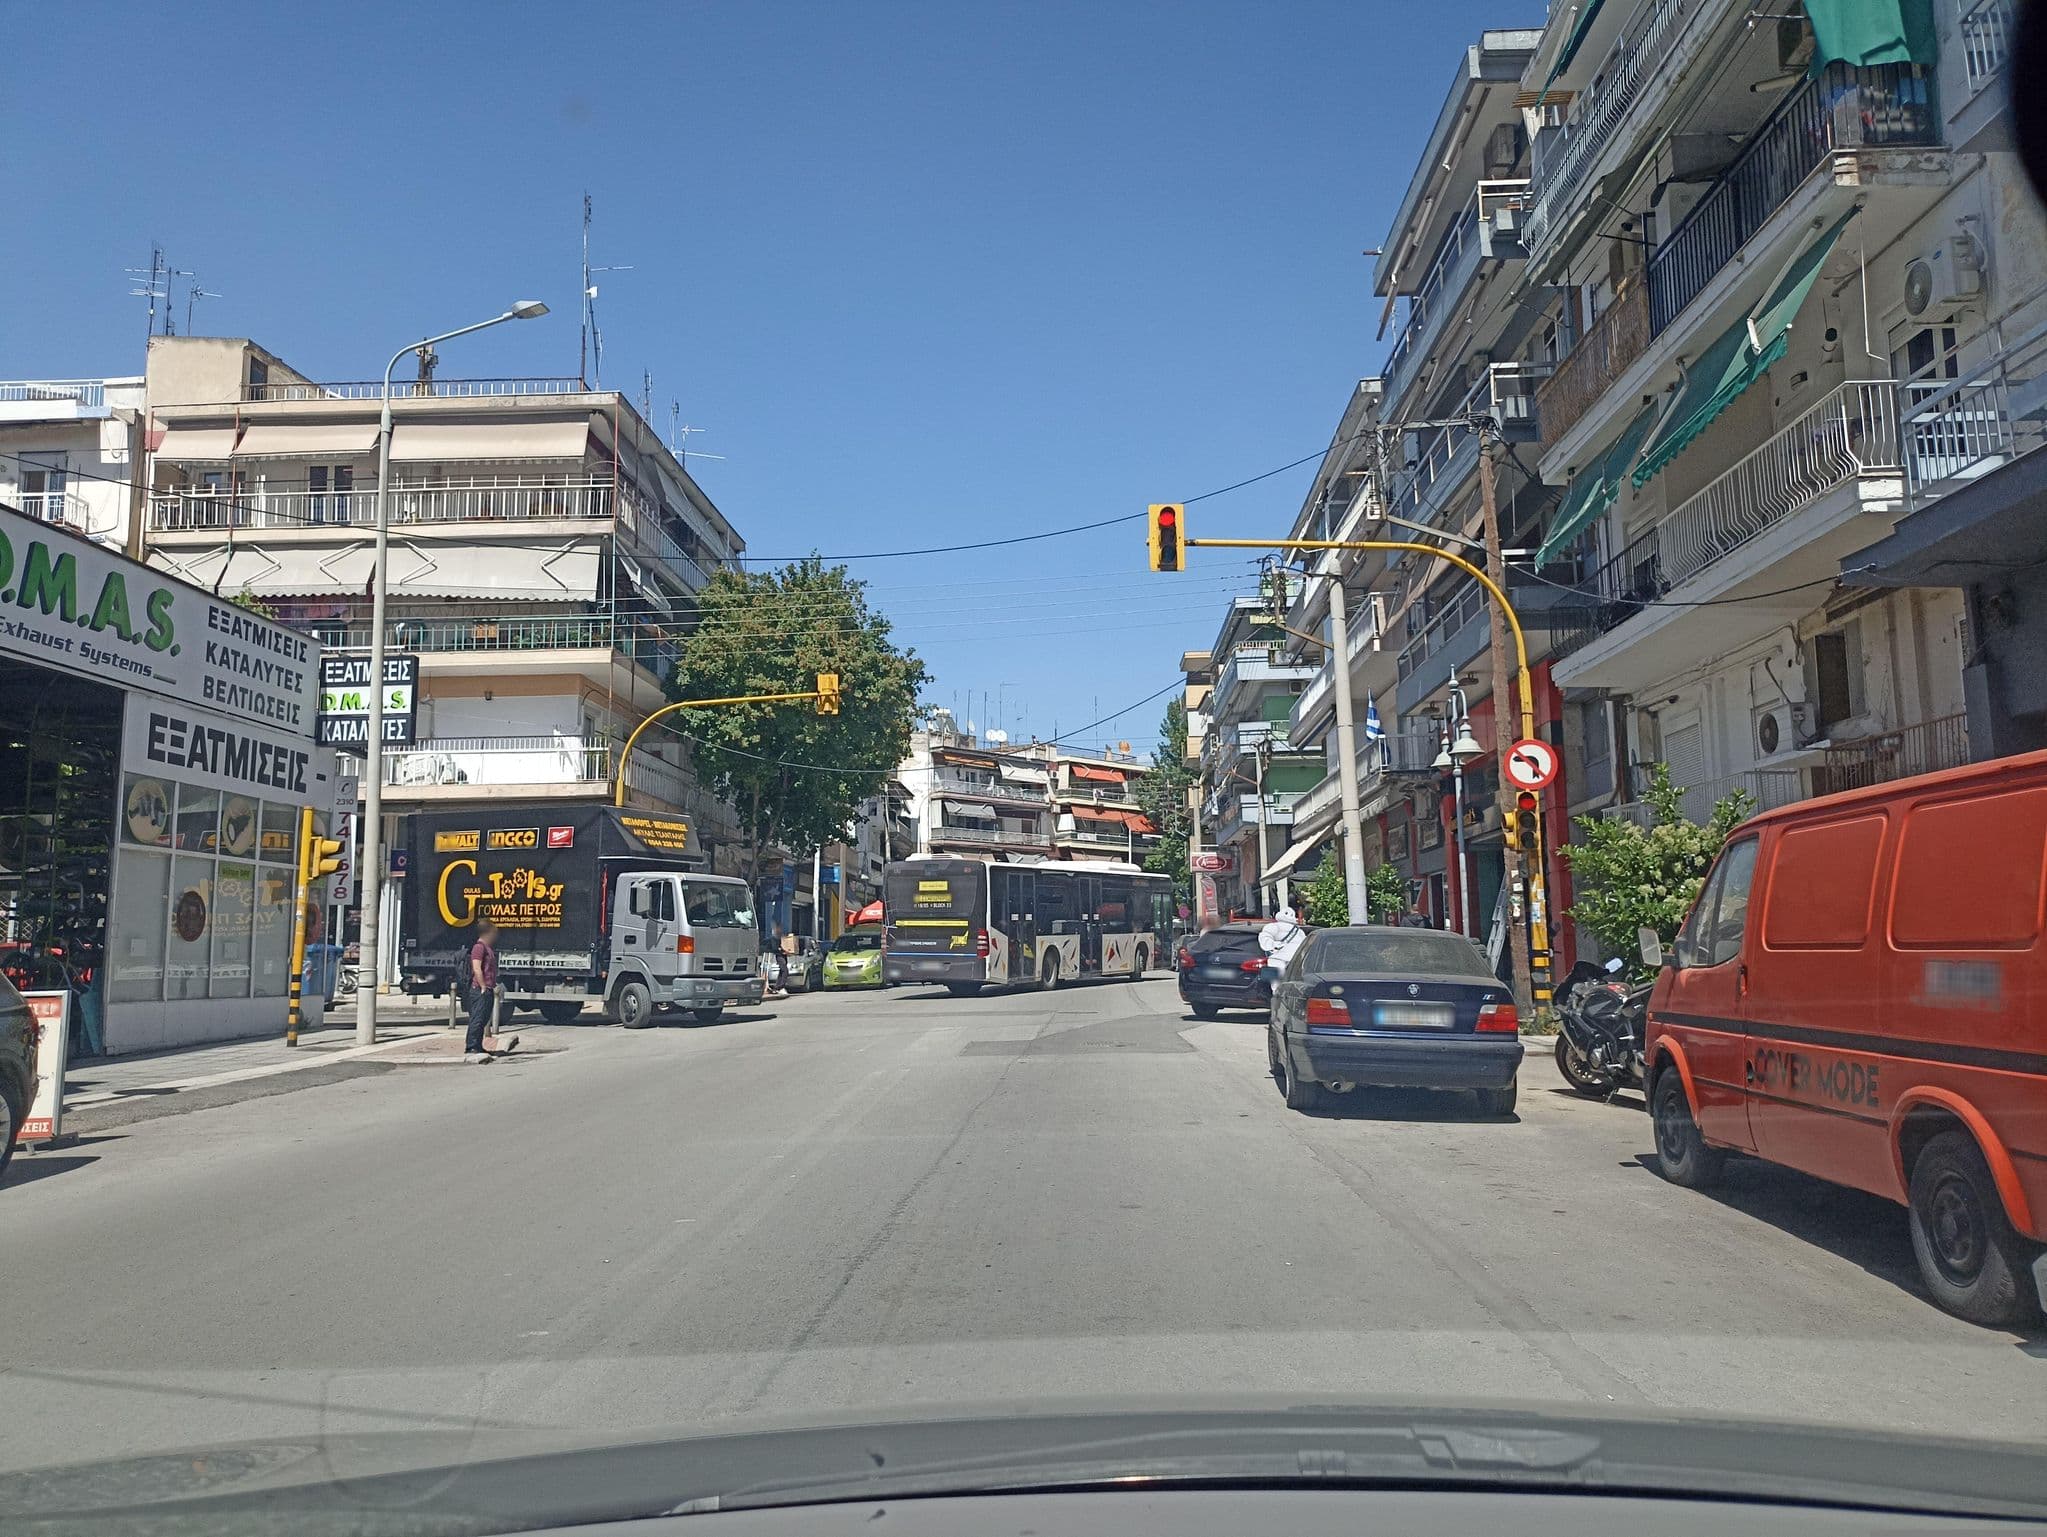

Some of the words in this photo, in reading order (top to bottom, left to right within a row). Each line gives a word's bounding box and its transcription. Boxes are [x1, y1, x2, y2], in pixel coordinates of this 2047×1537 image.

[208, 605, 307, 663] ΕΞΑΤΜΙΣΕΙΣ
[79, 641, 153, 677] Systems
[205, 640, 303, 694] ΚΑΤΑΛΥΤΕΣ
[203, 675, 300, 725] ΒΕΛΤΙΩΣΕΙΣ
[320, 690, 406, 712] D.M..S.
[322, 719, 407, 741] ΚΑΤΑΛΤΕΣ
[147, 712, 309, 793] ΕΞΑΤΜΙΣΕΙΣ
[478, 903, 517, 916] ΓΟΥΛΑΣ
[519, 903, 562, 916] ΠΕΤΡΟΣ
[499, 959, 566, 967] ΜΕΤΑΚΟΜΙΣΕΙΣ
[1816, 1059, 1880, 1108] MODE
